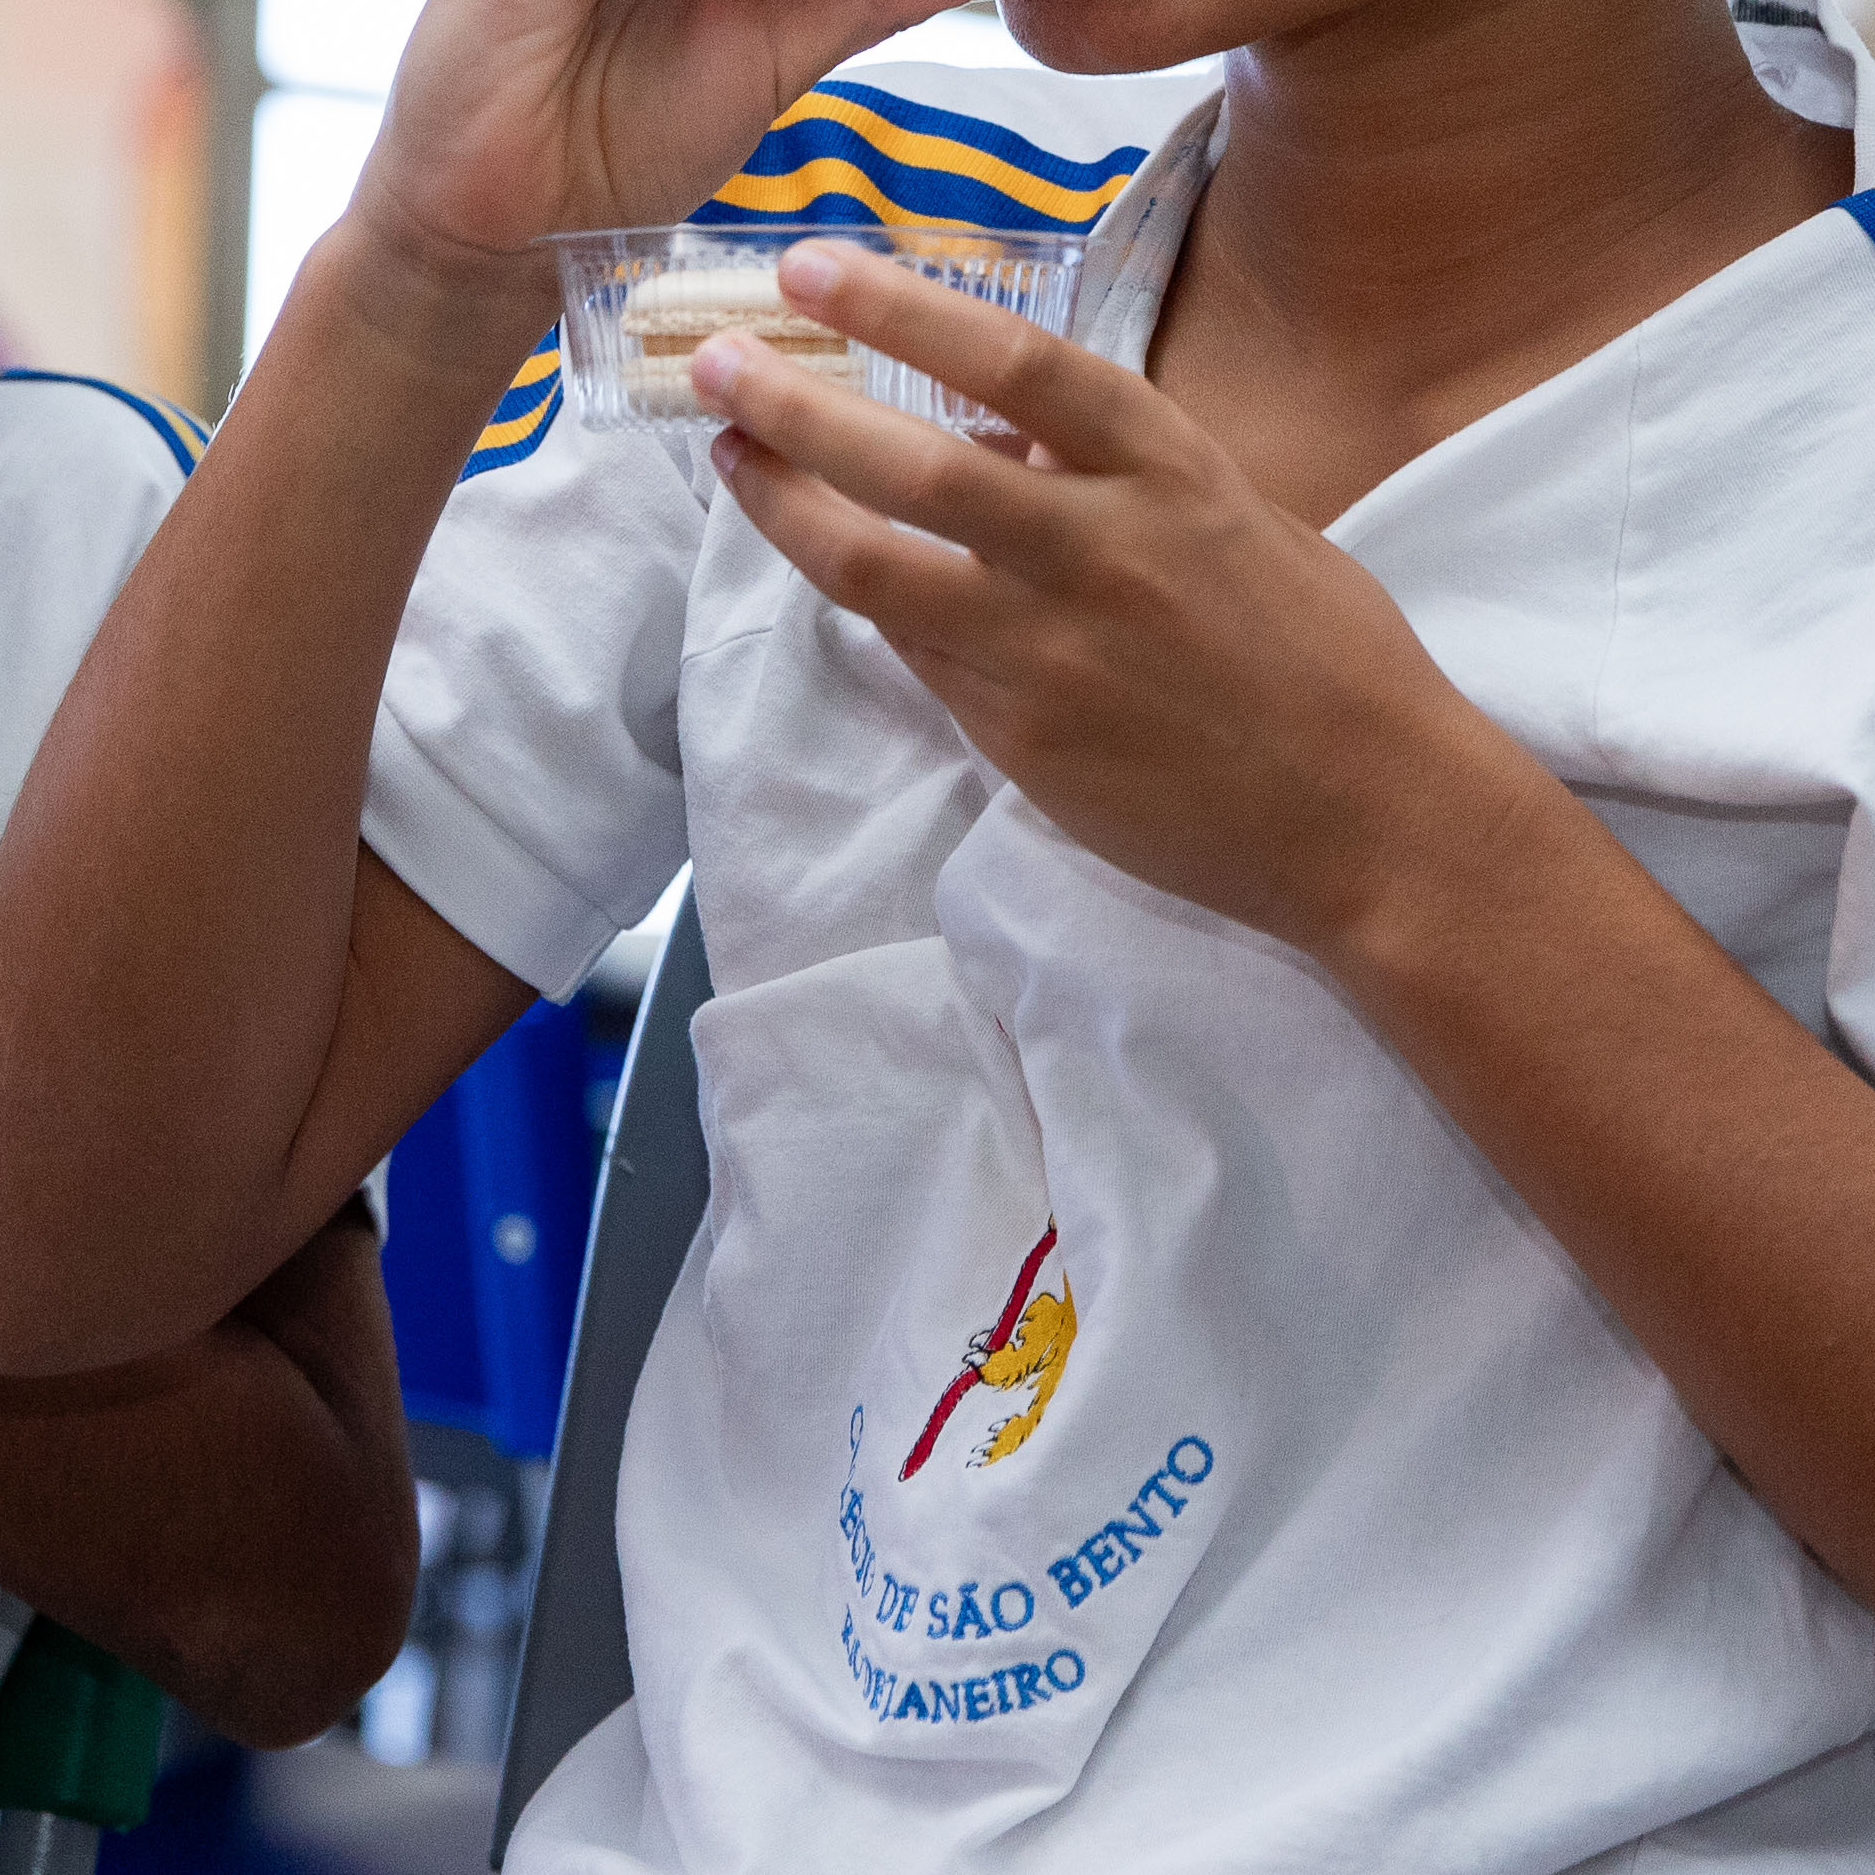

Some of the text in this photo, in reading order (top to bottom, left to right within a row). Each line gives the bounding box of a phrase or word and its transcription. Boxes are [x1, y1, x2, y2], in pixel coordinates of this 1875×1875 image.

[875, 1572, 920, 1633] DE
[926, 1580, 1035, 1641] SÃO
[1047, 1434, 1215, 1609] BENTO
